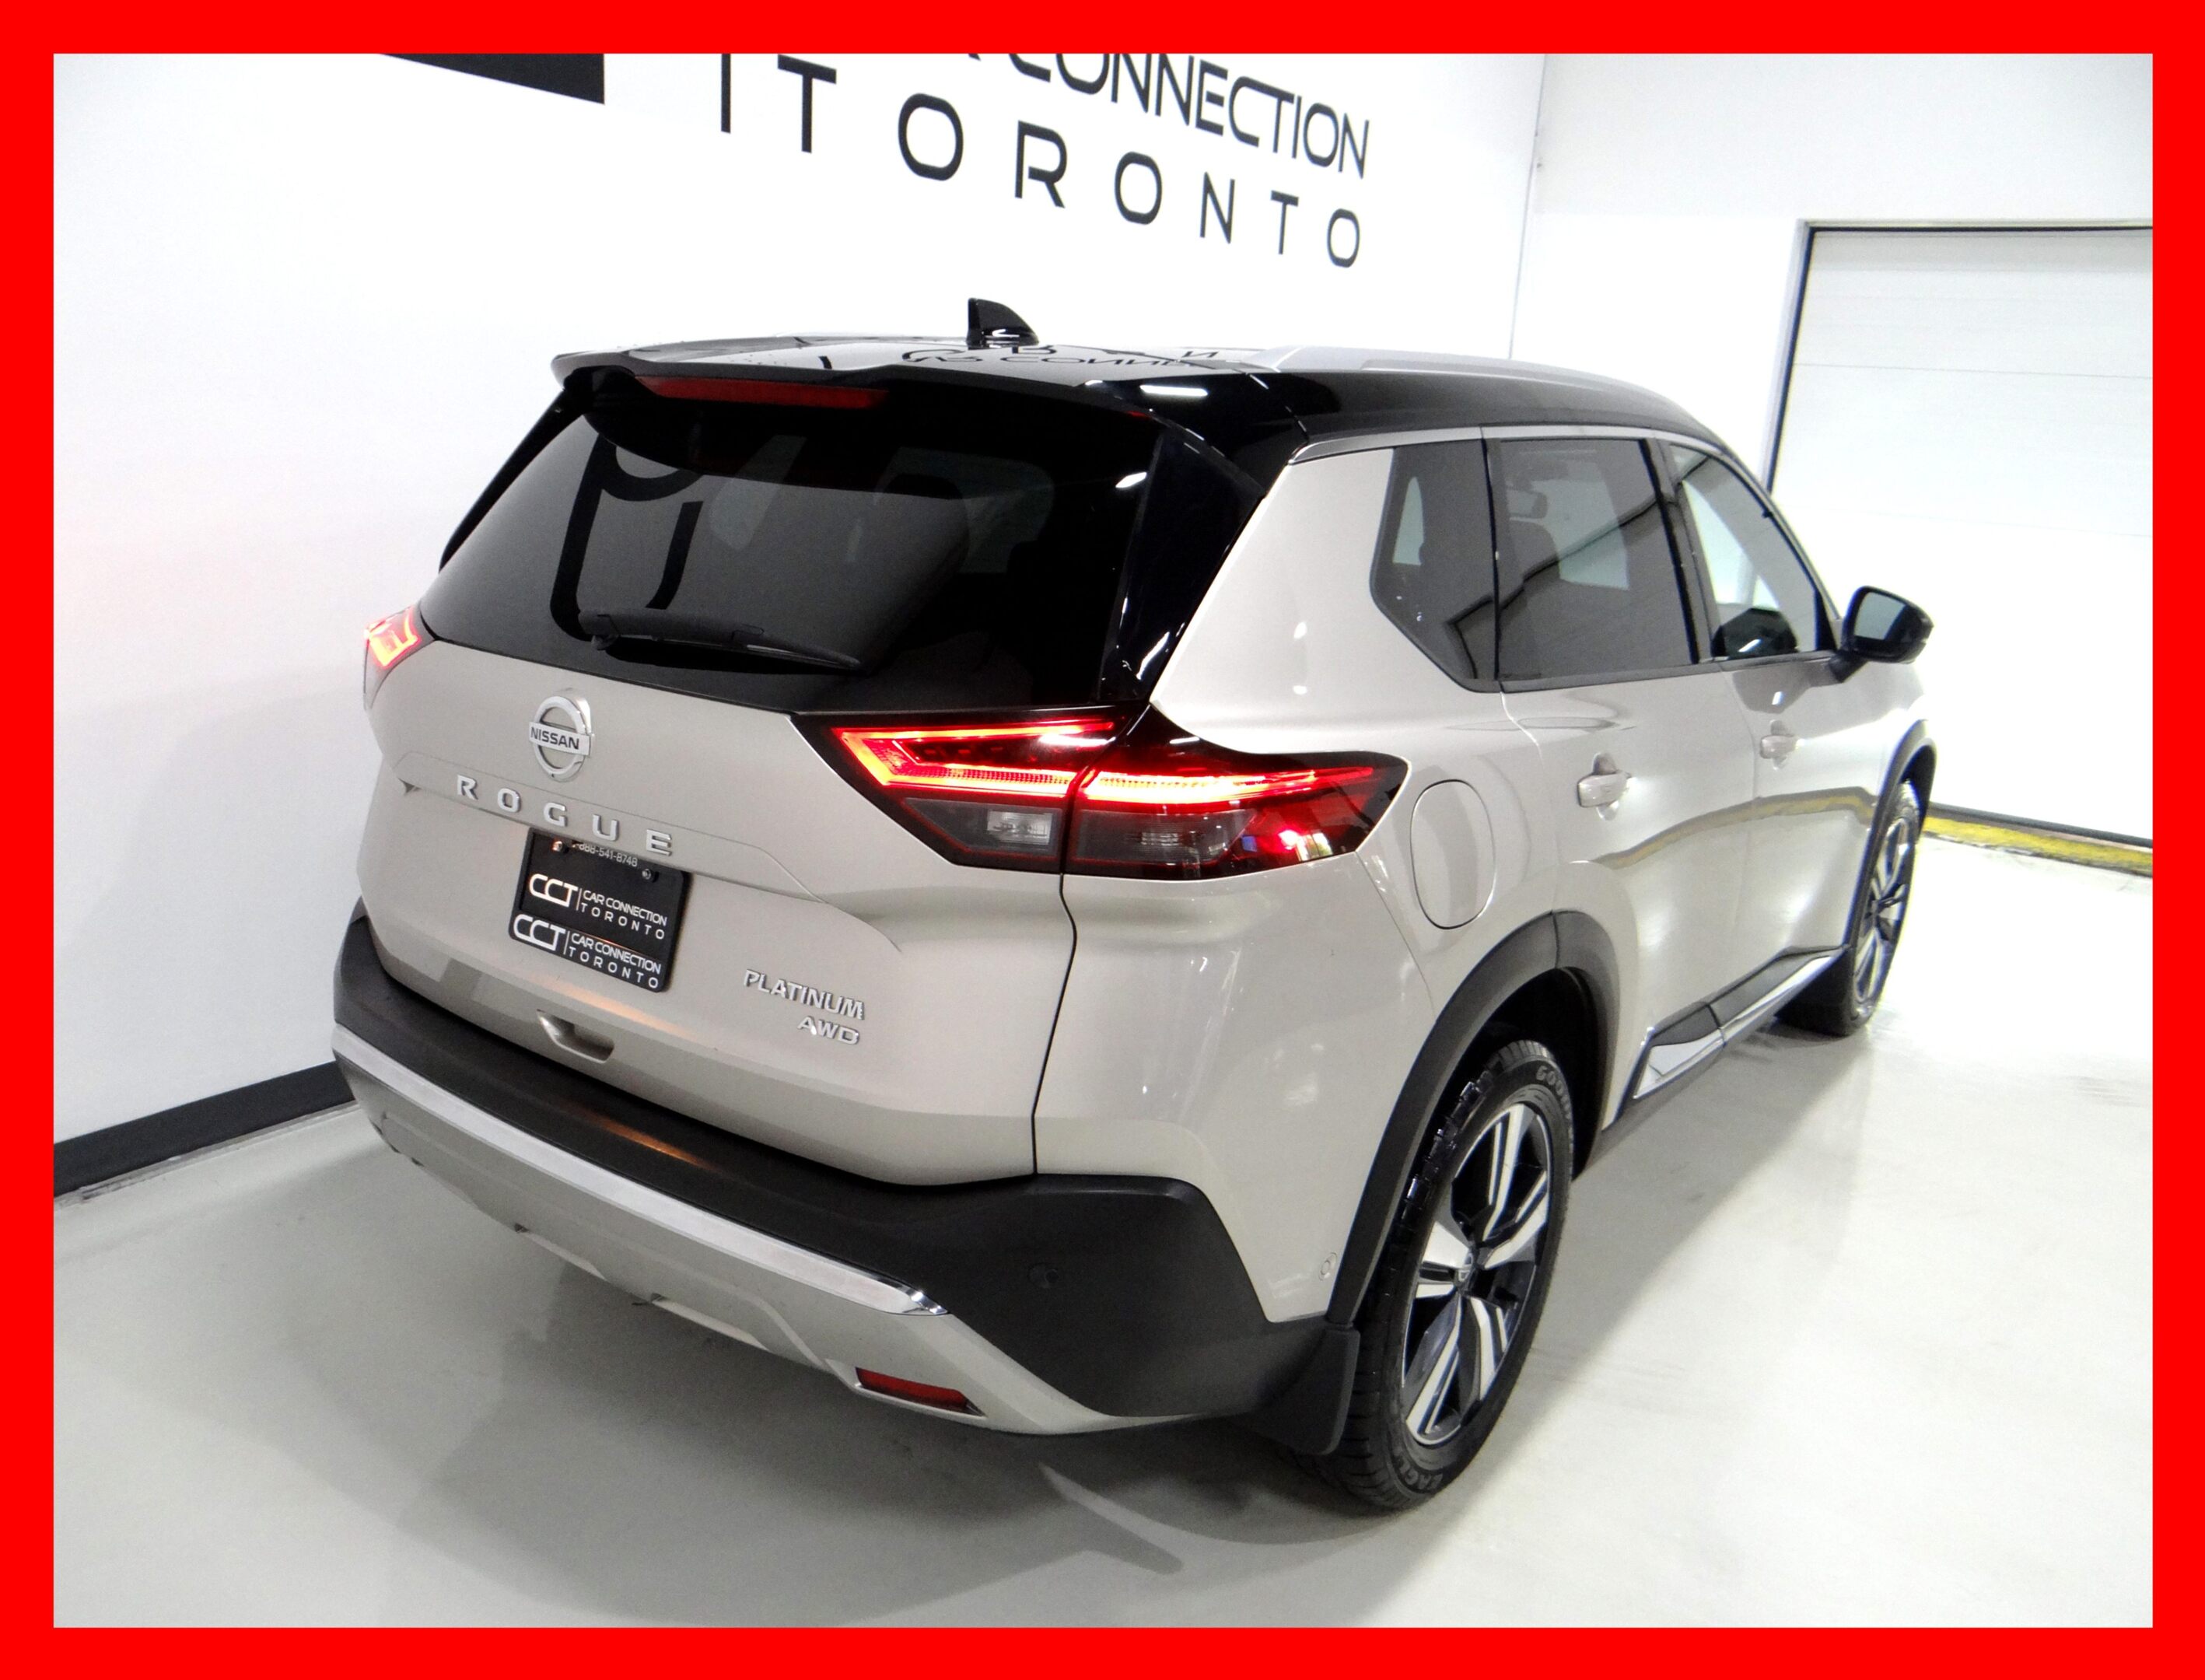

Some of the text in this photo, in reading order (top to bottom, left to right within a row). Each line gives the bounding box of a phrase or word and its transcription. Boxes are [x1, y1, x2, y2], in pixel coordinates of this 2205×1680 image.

[777, 54, 1360, 268] TORONTO
[530, 726, 579, 751] NISSAN
[457, 774, 673, 856] ROGUE
[529, 873, 579, 908] CCT
[583, 890, 668, 926] CAR CONNECTION
[513, 913, 566, 951] CCT
[581, 902, 665, 940] TORONTO
[569, 947, 659, 989] TORONTO
[571, 933, 661, 975] CAR CONNECTION
[744, 968, 865, 1020] PLATINUM
[796, 1015, 860, 1045] AWD
